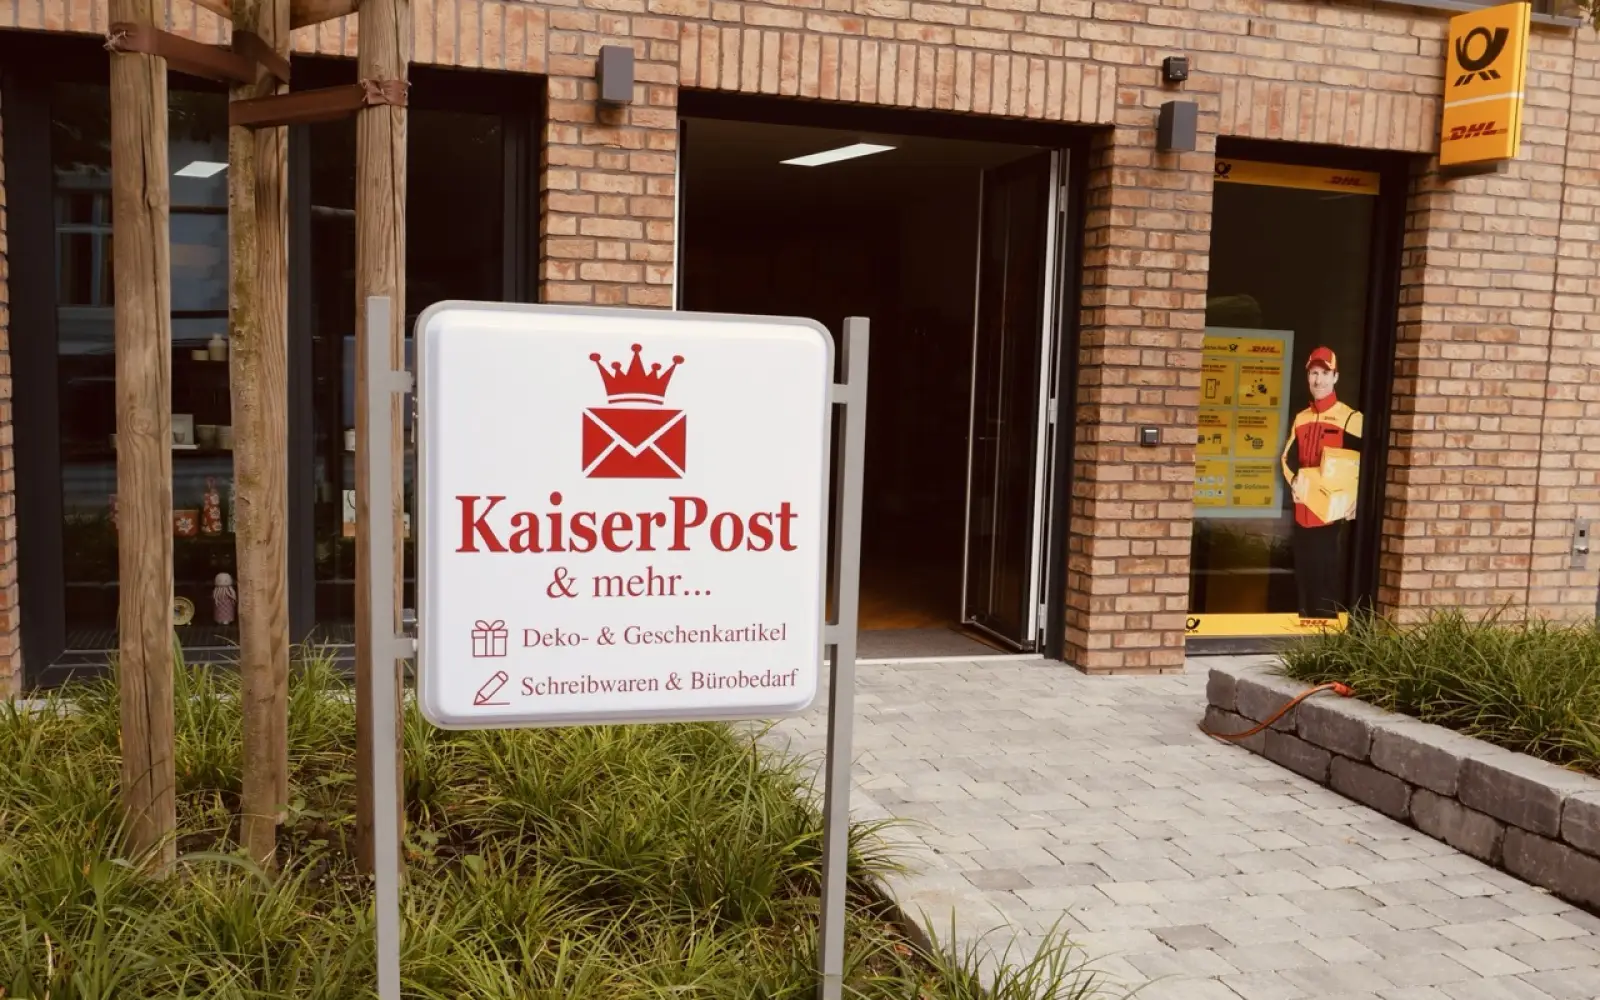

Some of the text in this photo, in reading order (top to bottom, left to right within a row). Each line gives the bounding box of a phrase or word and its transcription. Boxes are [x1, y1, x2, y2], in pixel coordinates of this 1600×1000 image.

[1449, 121, 1498, 140] DHL
[1331, 176, 1361, 187] DHL
[455, 491, 798, 553] KaiserPost
[546, 566, 710, 598] & mehr...
[524, 623, 785, 647] Deko- & Geschenkartikel
[522, 669, 798, 696] Schreibwaren & Bürobedarf
